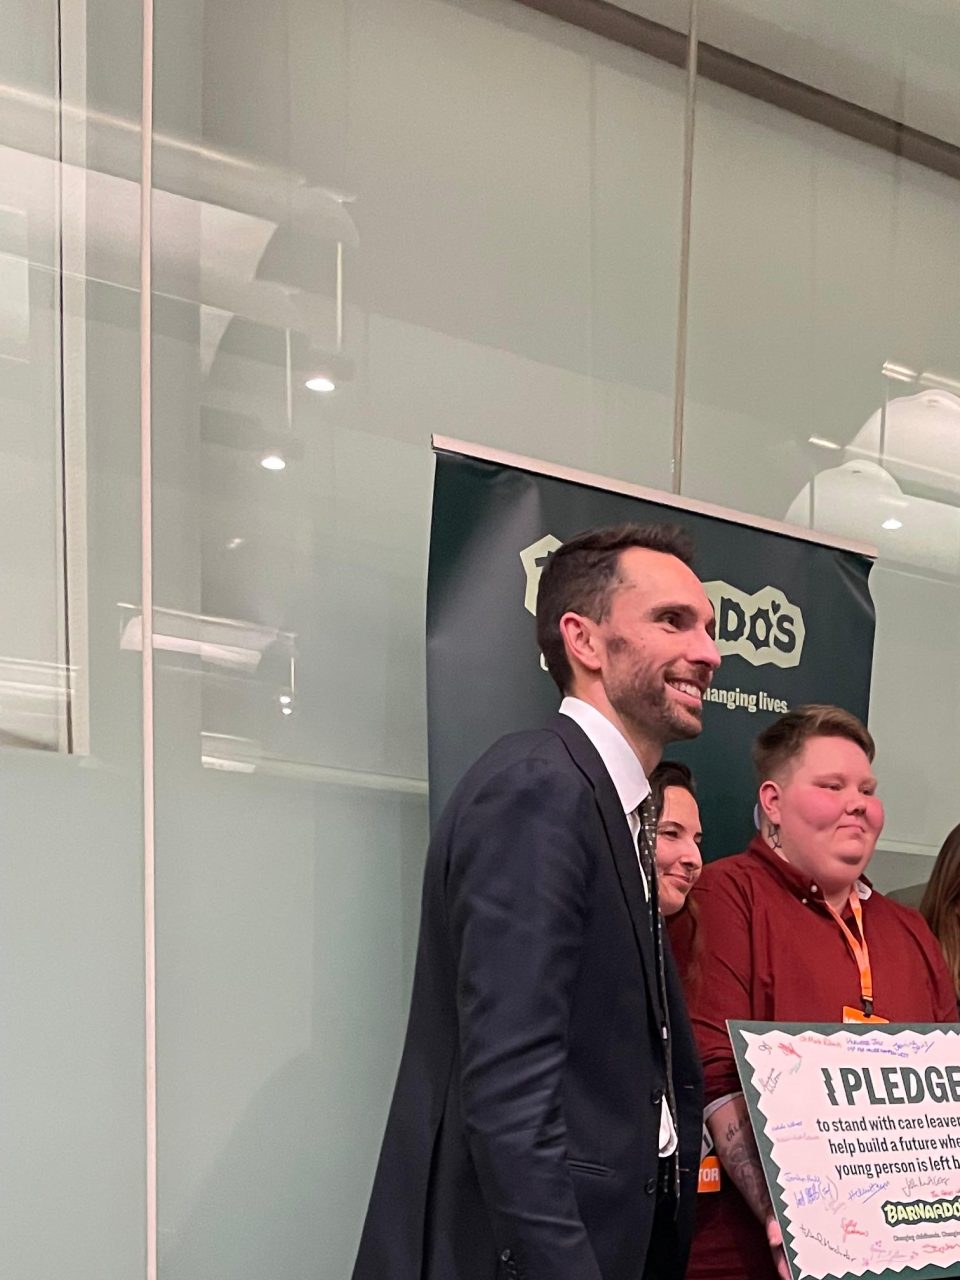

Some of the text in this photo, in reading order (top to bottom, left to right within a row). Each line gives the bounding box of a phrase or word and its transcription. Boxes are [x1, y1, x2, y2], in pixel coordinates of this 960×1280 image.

[821, 1067, 839, 1106] I
[816, 1118, 830, 1133] to
[832, 1116, 868, 1132] stand
[869, 1115, 897, 1131] with
[898, 1117, 924, 1130] care
[828, 1138, 856, 1158] help
[857, 1137, 889, 1153] build
[890, 1140, 898, 1152] a
[899, 1136, 938, 1152] future
[834, 1163, 873, 1180] young
[874, 1161, 918, 1179] person
[917, 1158, 927, 1172] is
[928, 1155, 951, 1171] left
